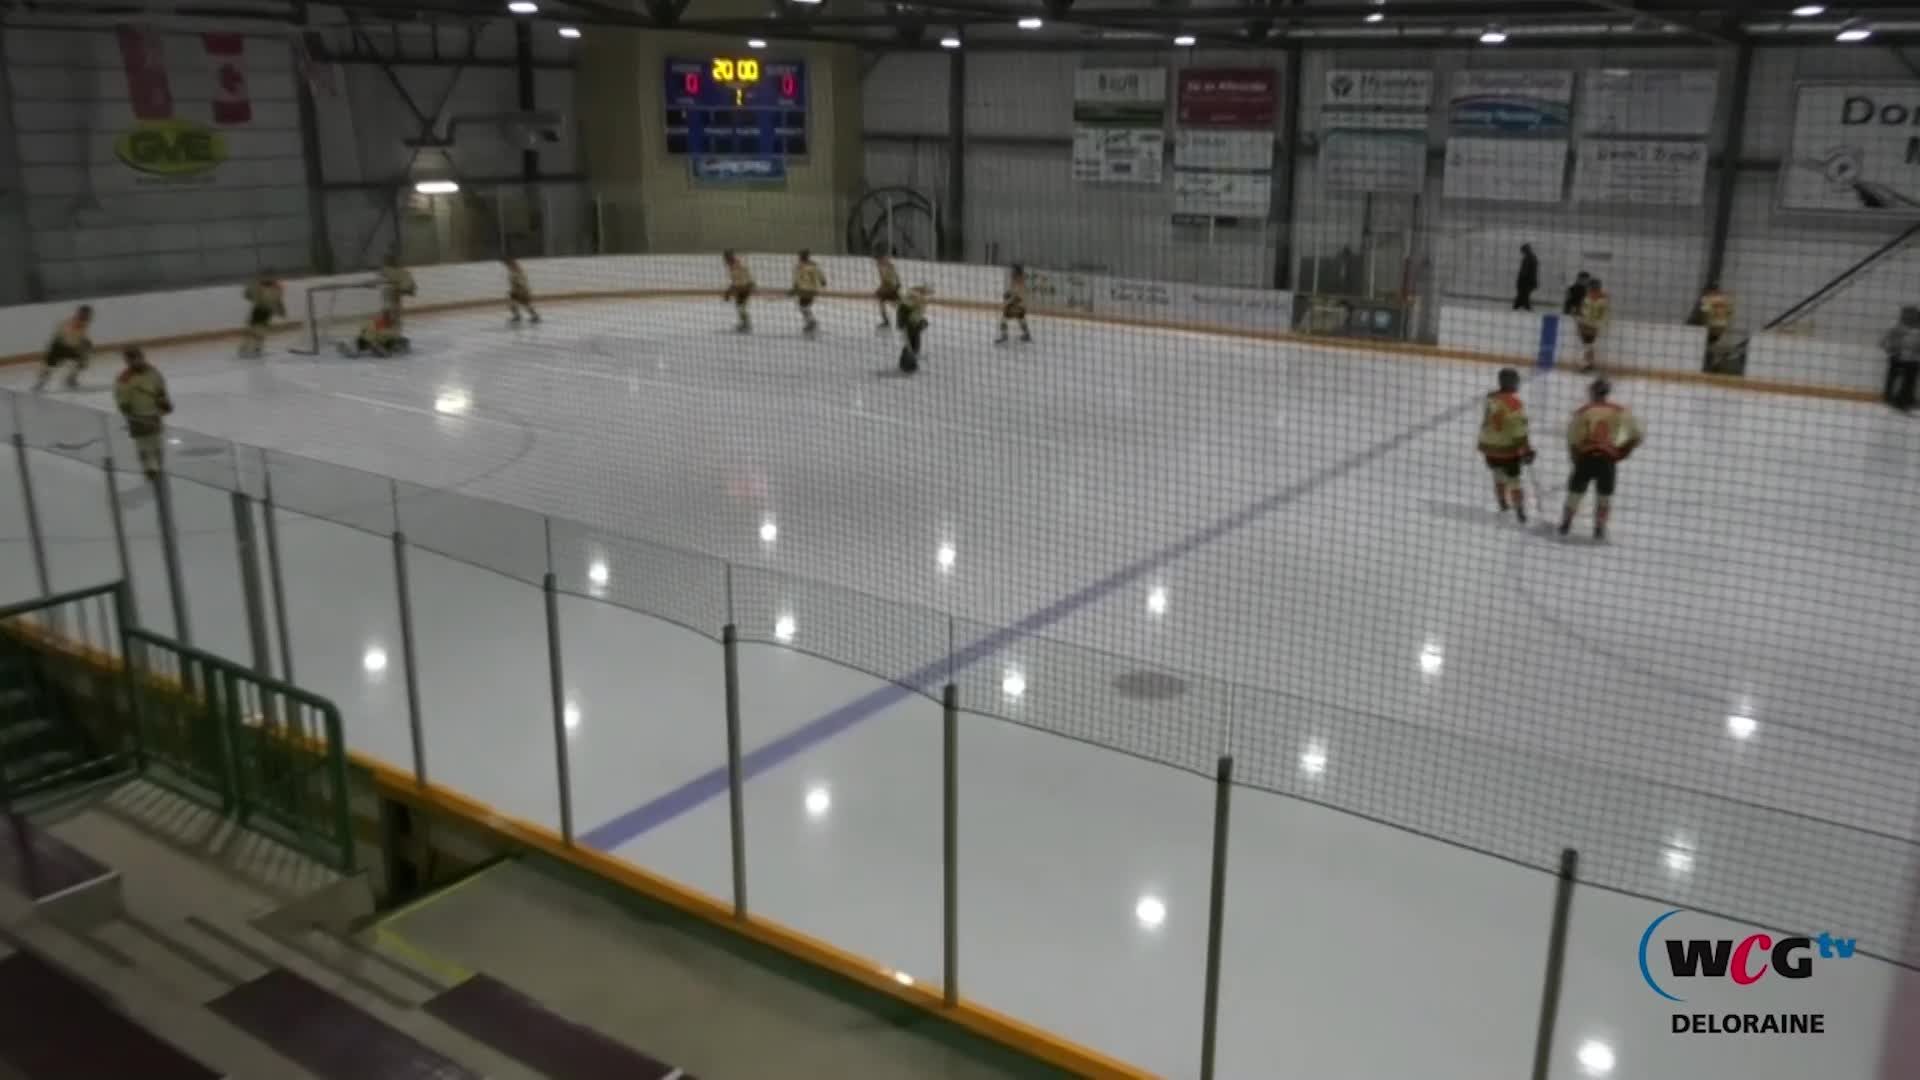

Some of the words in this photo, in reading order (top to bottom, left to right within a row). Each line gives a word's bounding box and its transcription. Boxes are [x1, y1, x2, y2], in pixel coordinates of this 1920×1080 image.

[711, 57, 734, 81] 20
[737, 59, 760, 81] 00
[685, 73, 699, 94] 0
[782, 73, 796, 94] 0
